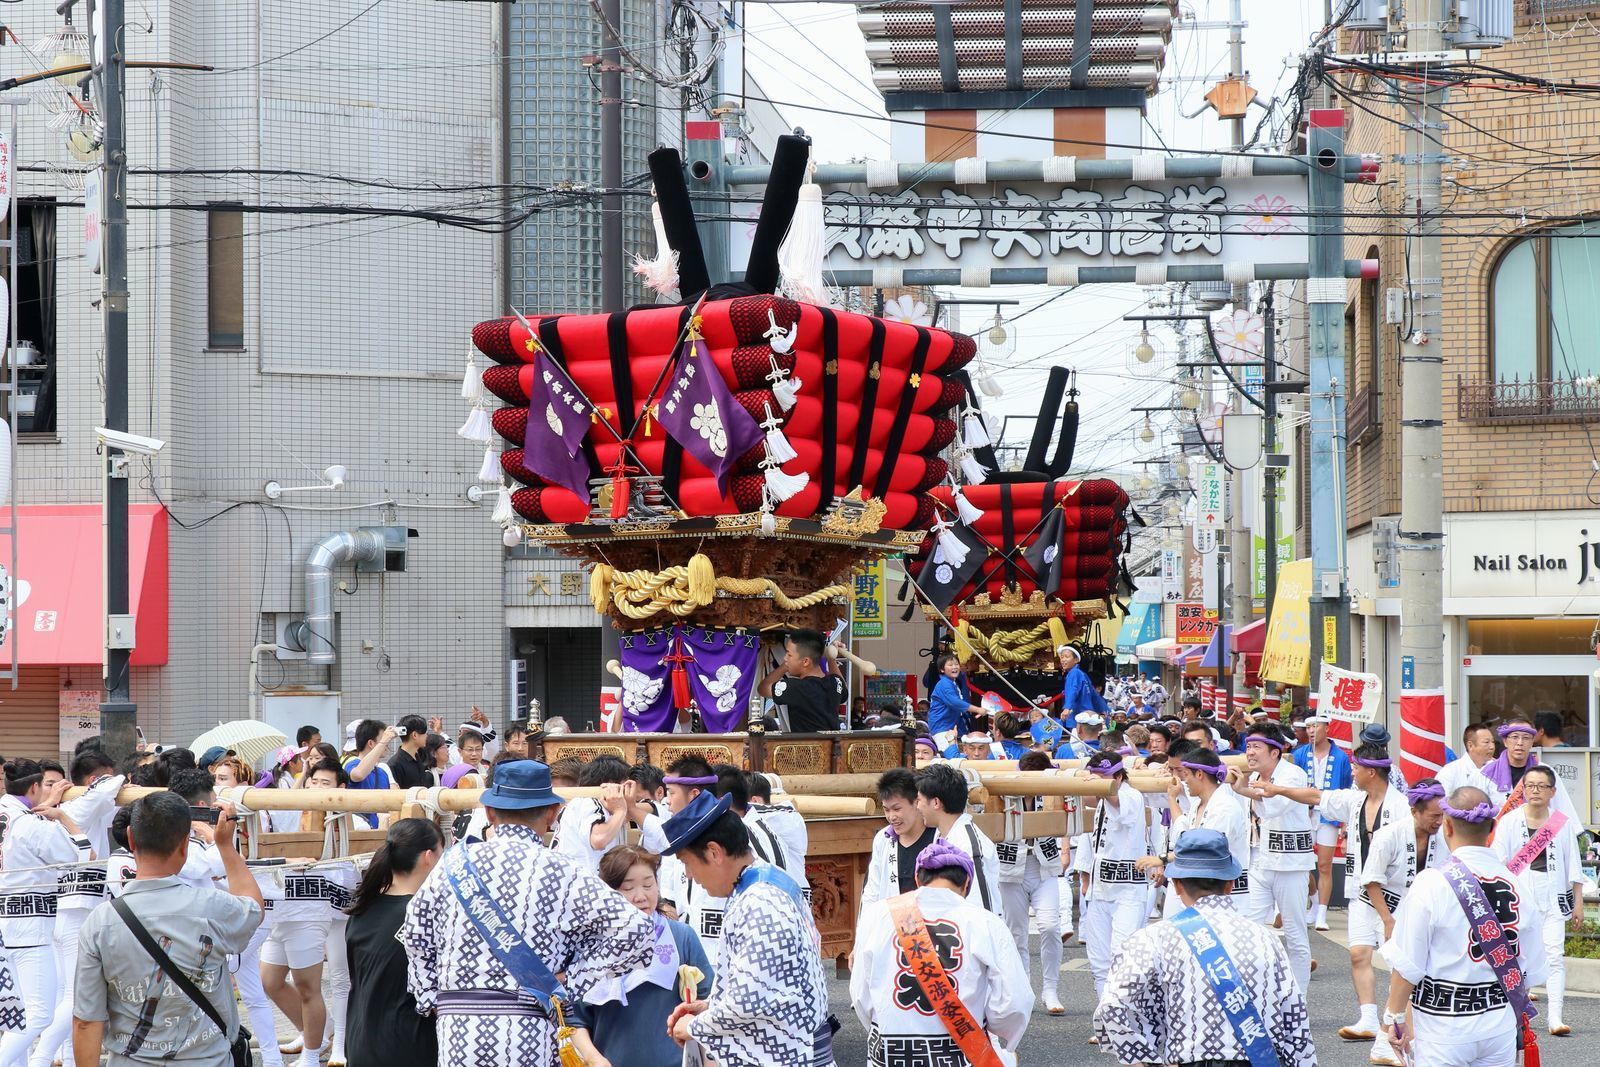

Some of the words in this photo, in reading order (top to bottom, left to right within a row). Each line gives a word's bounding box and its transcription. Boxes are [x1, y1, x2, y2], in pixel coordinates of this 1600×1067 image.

[1209, 480, 1220, 509] なかた
[1474, 555, 1510, 570] Nail
[1517, 555, 1567, 570] Salon
[1179, 608, 1201, 617] 激安
[1187, 927, 1266, 1047] 運行部長
